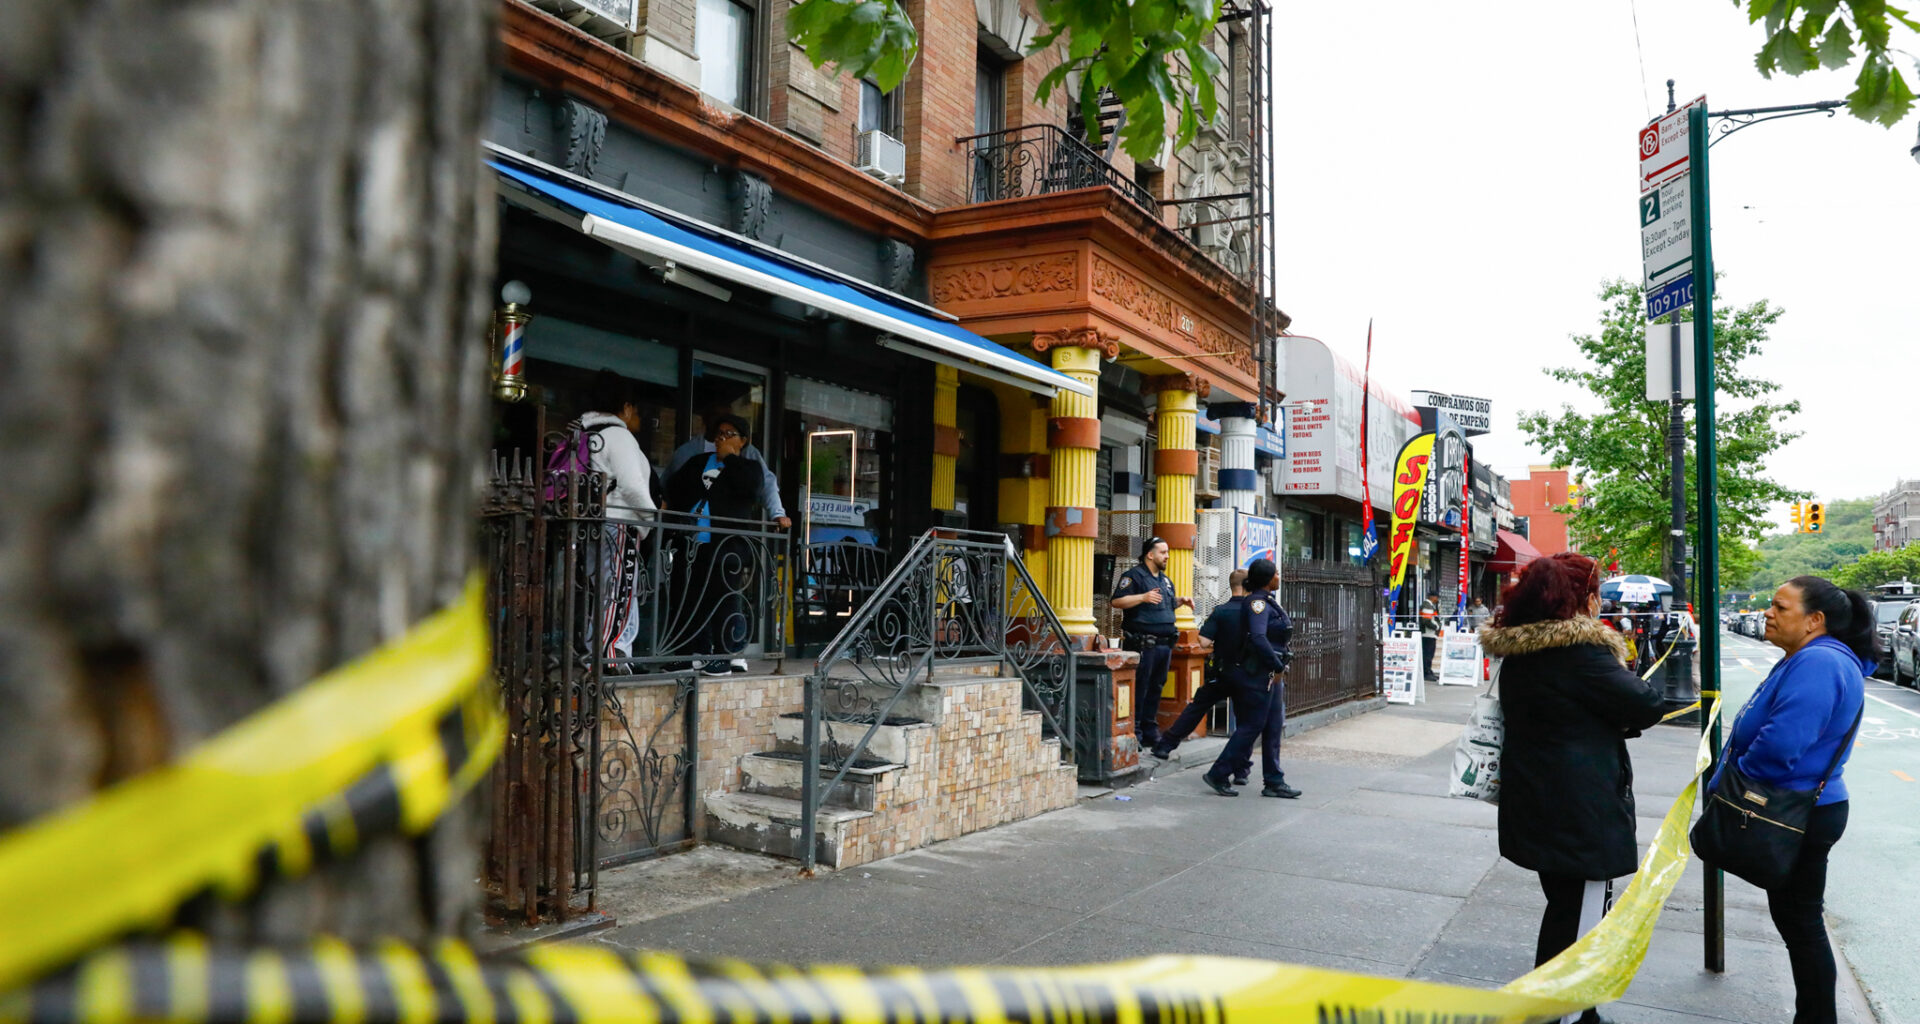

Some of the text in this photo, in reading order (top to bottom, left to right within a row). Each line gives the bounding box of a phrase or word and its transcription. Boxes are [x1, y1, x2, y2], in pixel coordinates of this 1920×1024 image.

[1676, 113, 1689, 126] 8:30
[1661, 126, 1689, 146] Except Sun
[1661, 187, 1673, 198] hour
[1662, 189, 1684, 207] metered
[1645, 197, 1656, 223] 2
[1663, 201, 1682, 217] parking
[1645, 229, 1667, 246] 8:30am
[1673, 218, 1687, 231] 7pm
[1646, 229, 1690, 258] Except Sunday
[1428, 394, 1490, 414] COMPRAMOS ORO
[1460, 414, 1489, 429] EMPEÑO
[1247, 522, 1275, 548] DENTISTA
